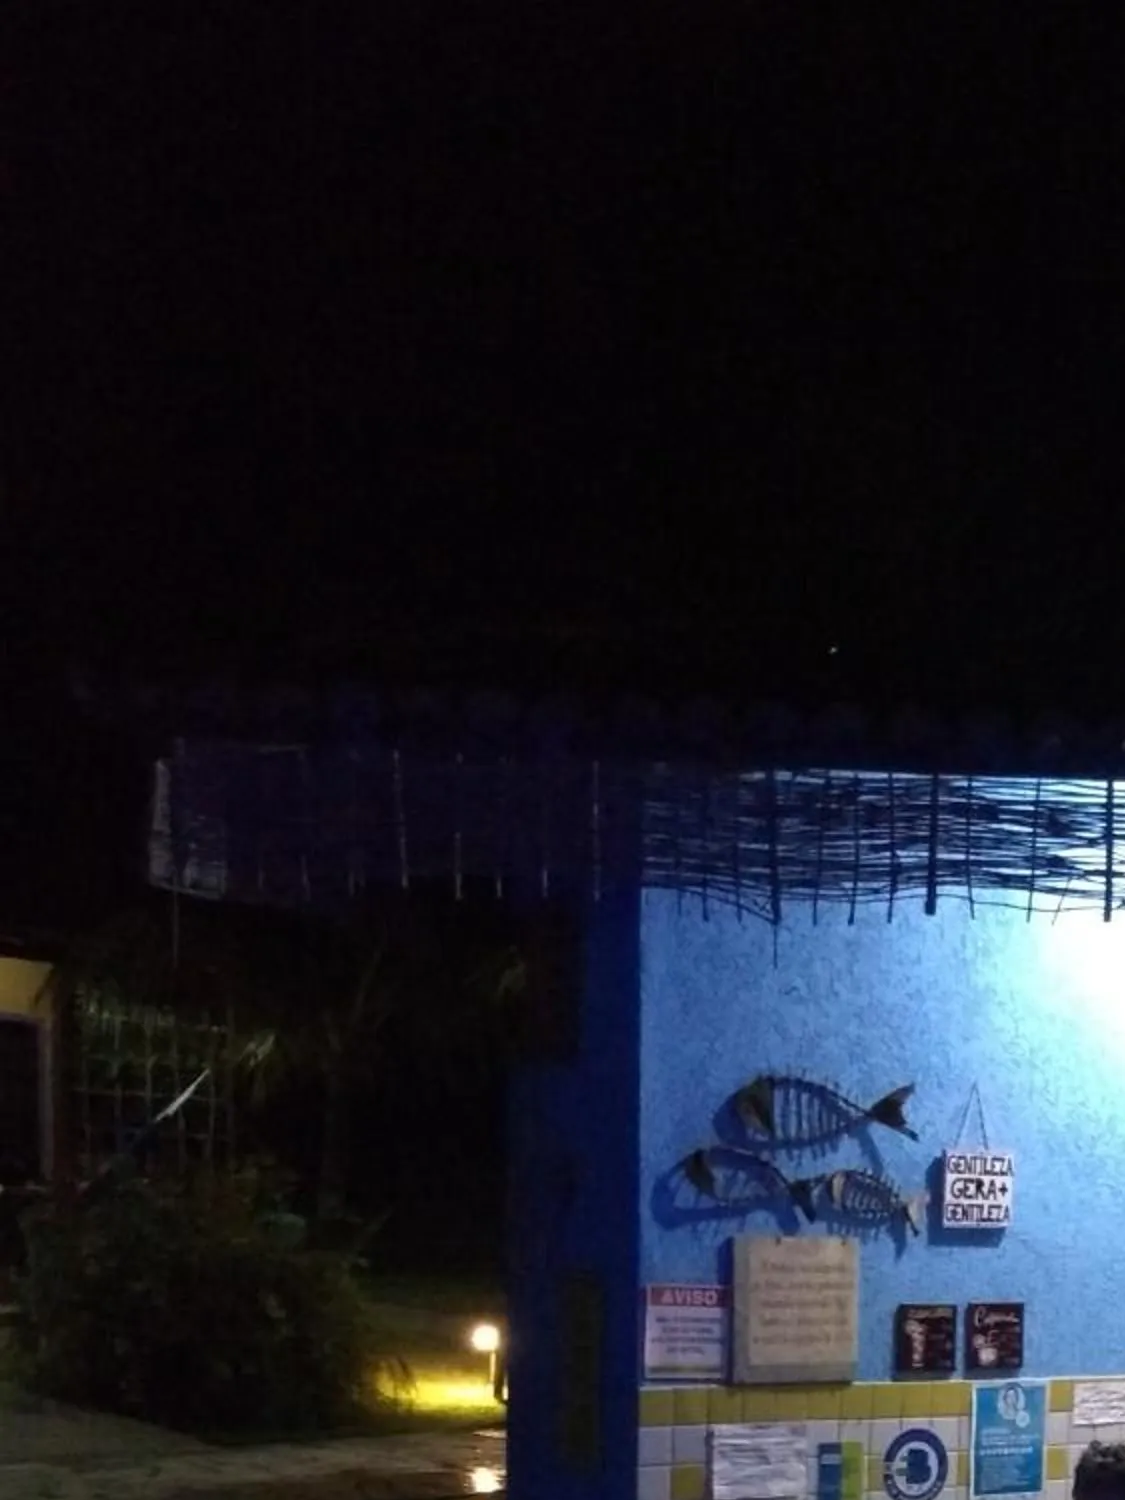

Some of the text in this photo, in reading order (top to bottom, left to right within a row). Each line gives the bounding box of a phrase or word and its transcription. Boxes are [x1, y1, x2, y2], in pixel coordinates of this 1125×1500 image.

[947, 1155, 1014, 1175] GENTILEZA
[951, 1178, 1008, 1200] GERA+
[946, 1204, 1009, 1222] GENTILEZA
[661, 1289, 718, 1305] AVISO
